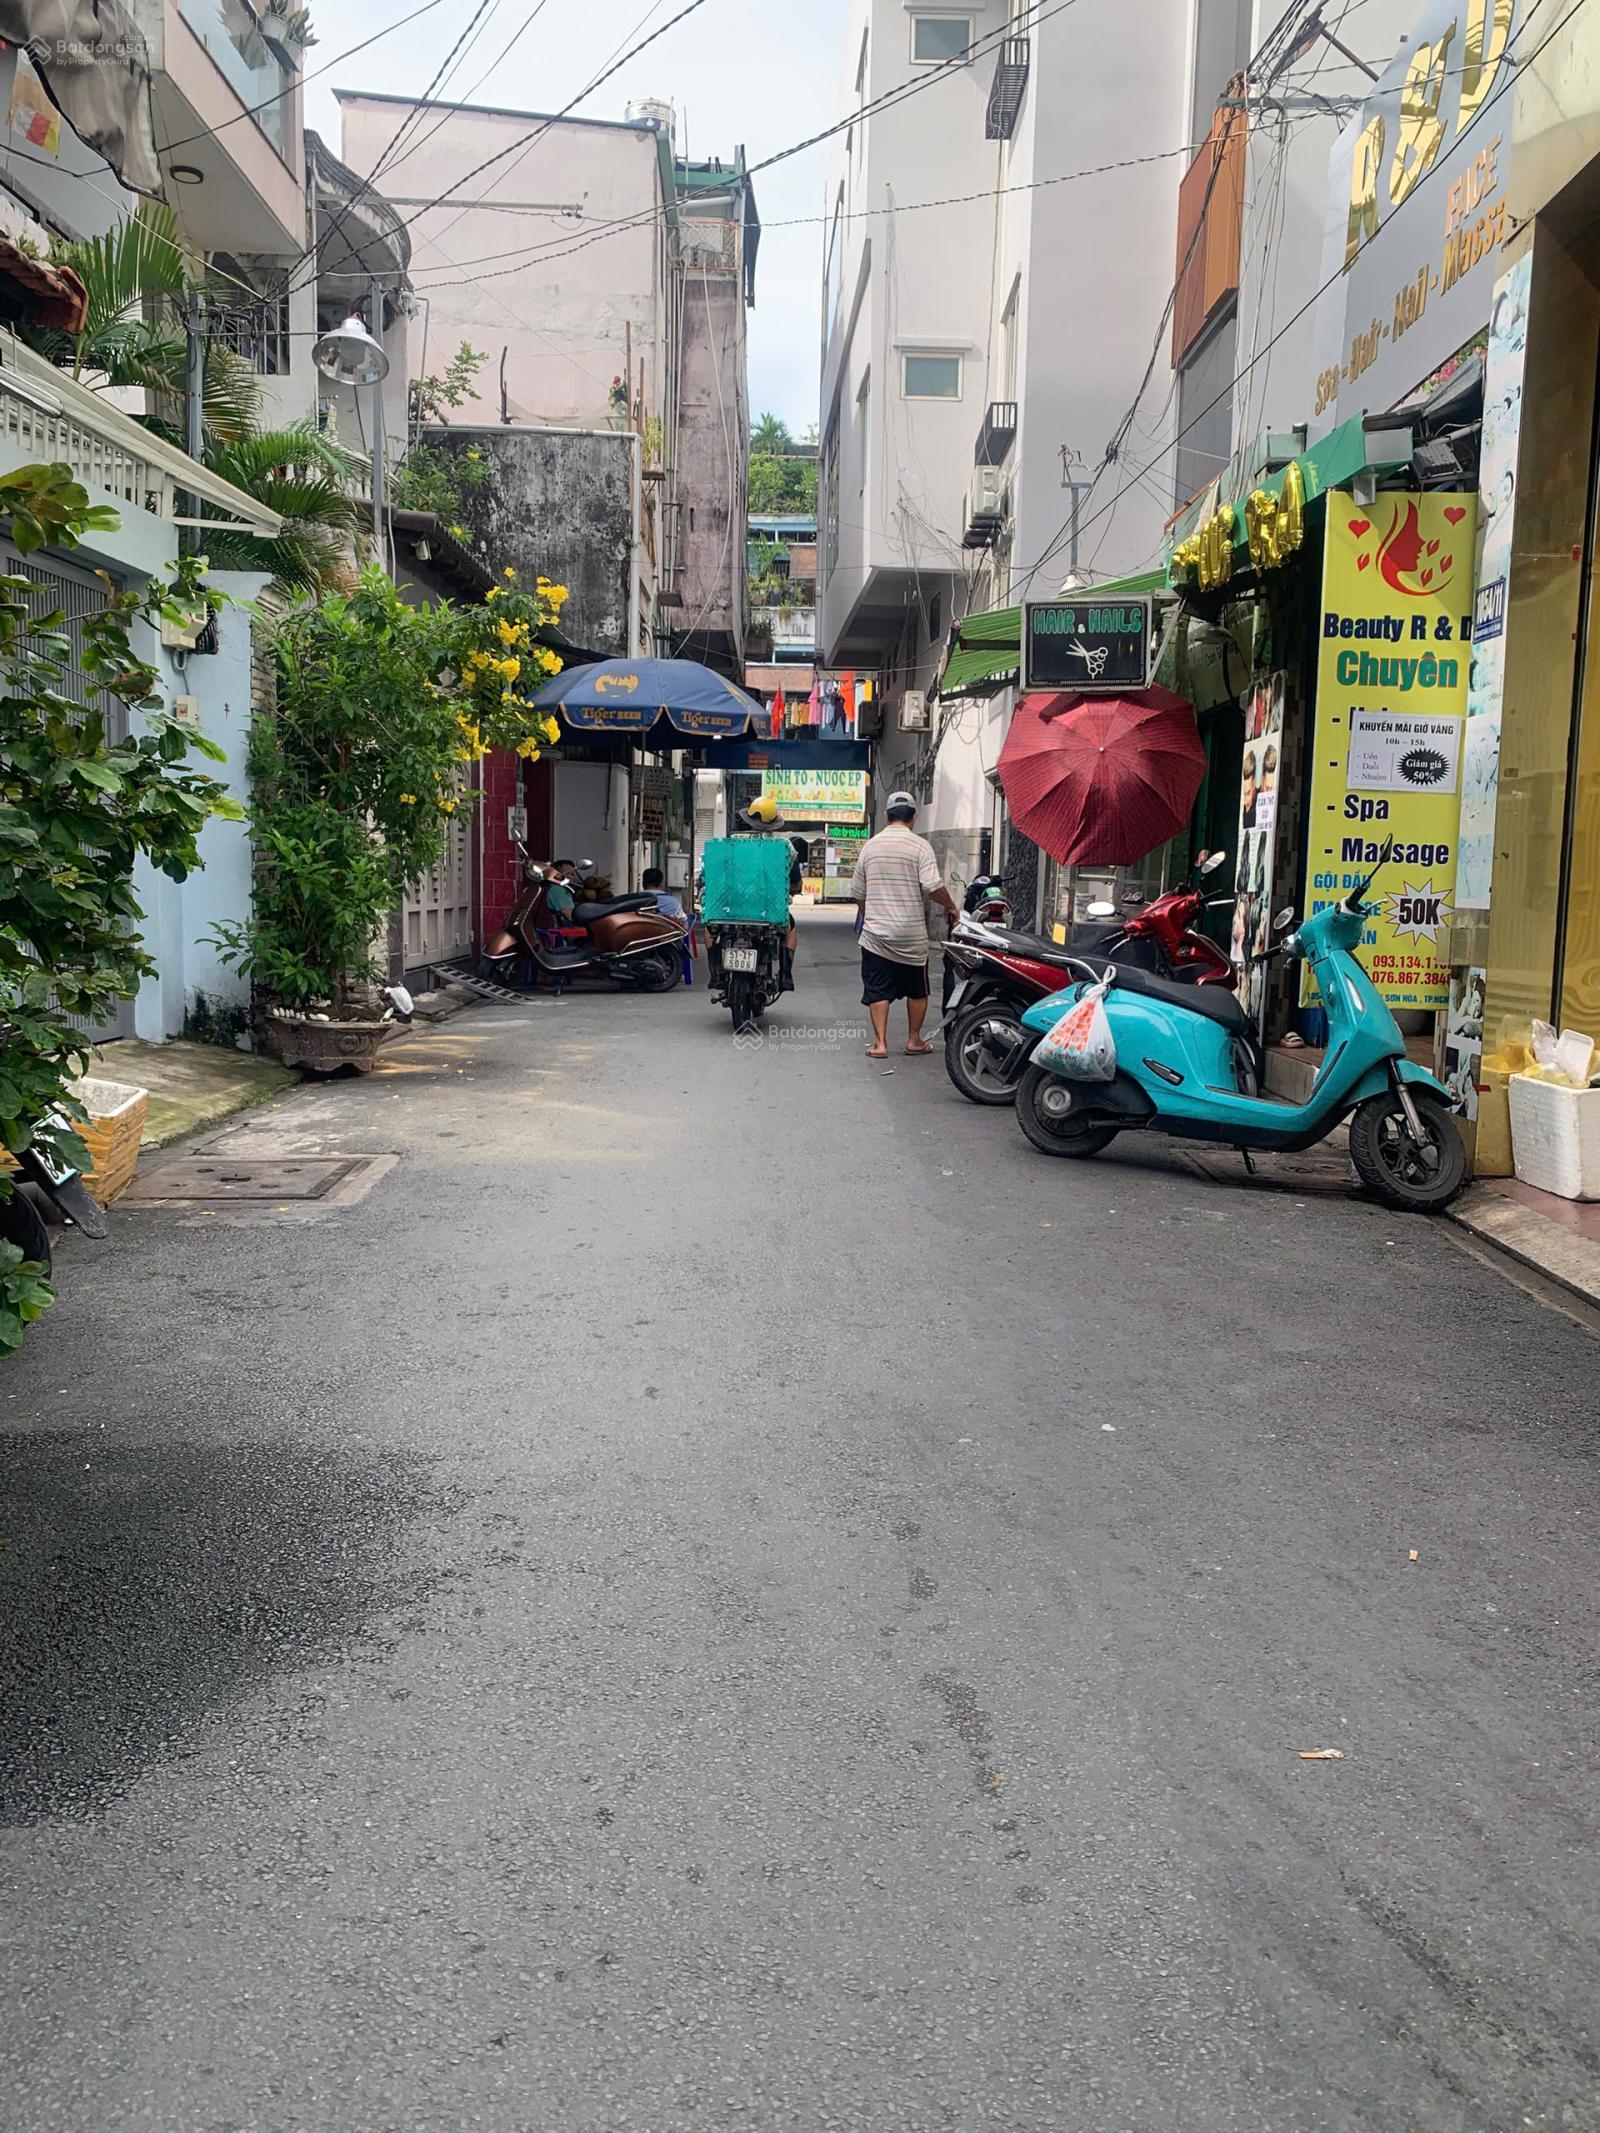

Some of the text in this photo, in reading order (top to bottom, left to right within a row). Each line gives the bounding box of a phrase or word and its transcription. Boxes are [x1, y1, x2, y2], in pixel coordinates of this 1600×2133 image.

[1349, 318, 1382, 385] Hair
[1392, 263, 1430, 343] Nail
[1033, 609, 1076, 634] HAIR
[1088, 607, 1142, 633] NAILS
[1323, 613, 1405, 643] Beauty
[1411, 615, 1427, 640] R
[1434, 615, 1453, 640] &
[1336, 650, 1458, 692] Chuyên
[582, 706, 617, 723] Tiger
[1413, 770, 1435, 781] 50%
[1344, 794, 1389, 822] Spa
[1400, 898, 1441, 925] 50K
[1373, 955, 1454, 969] 093.134.11
